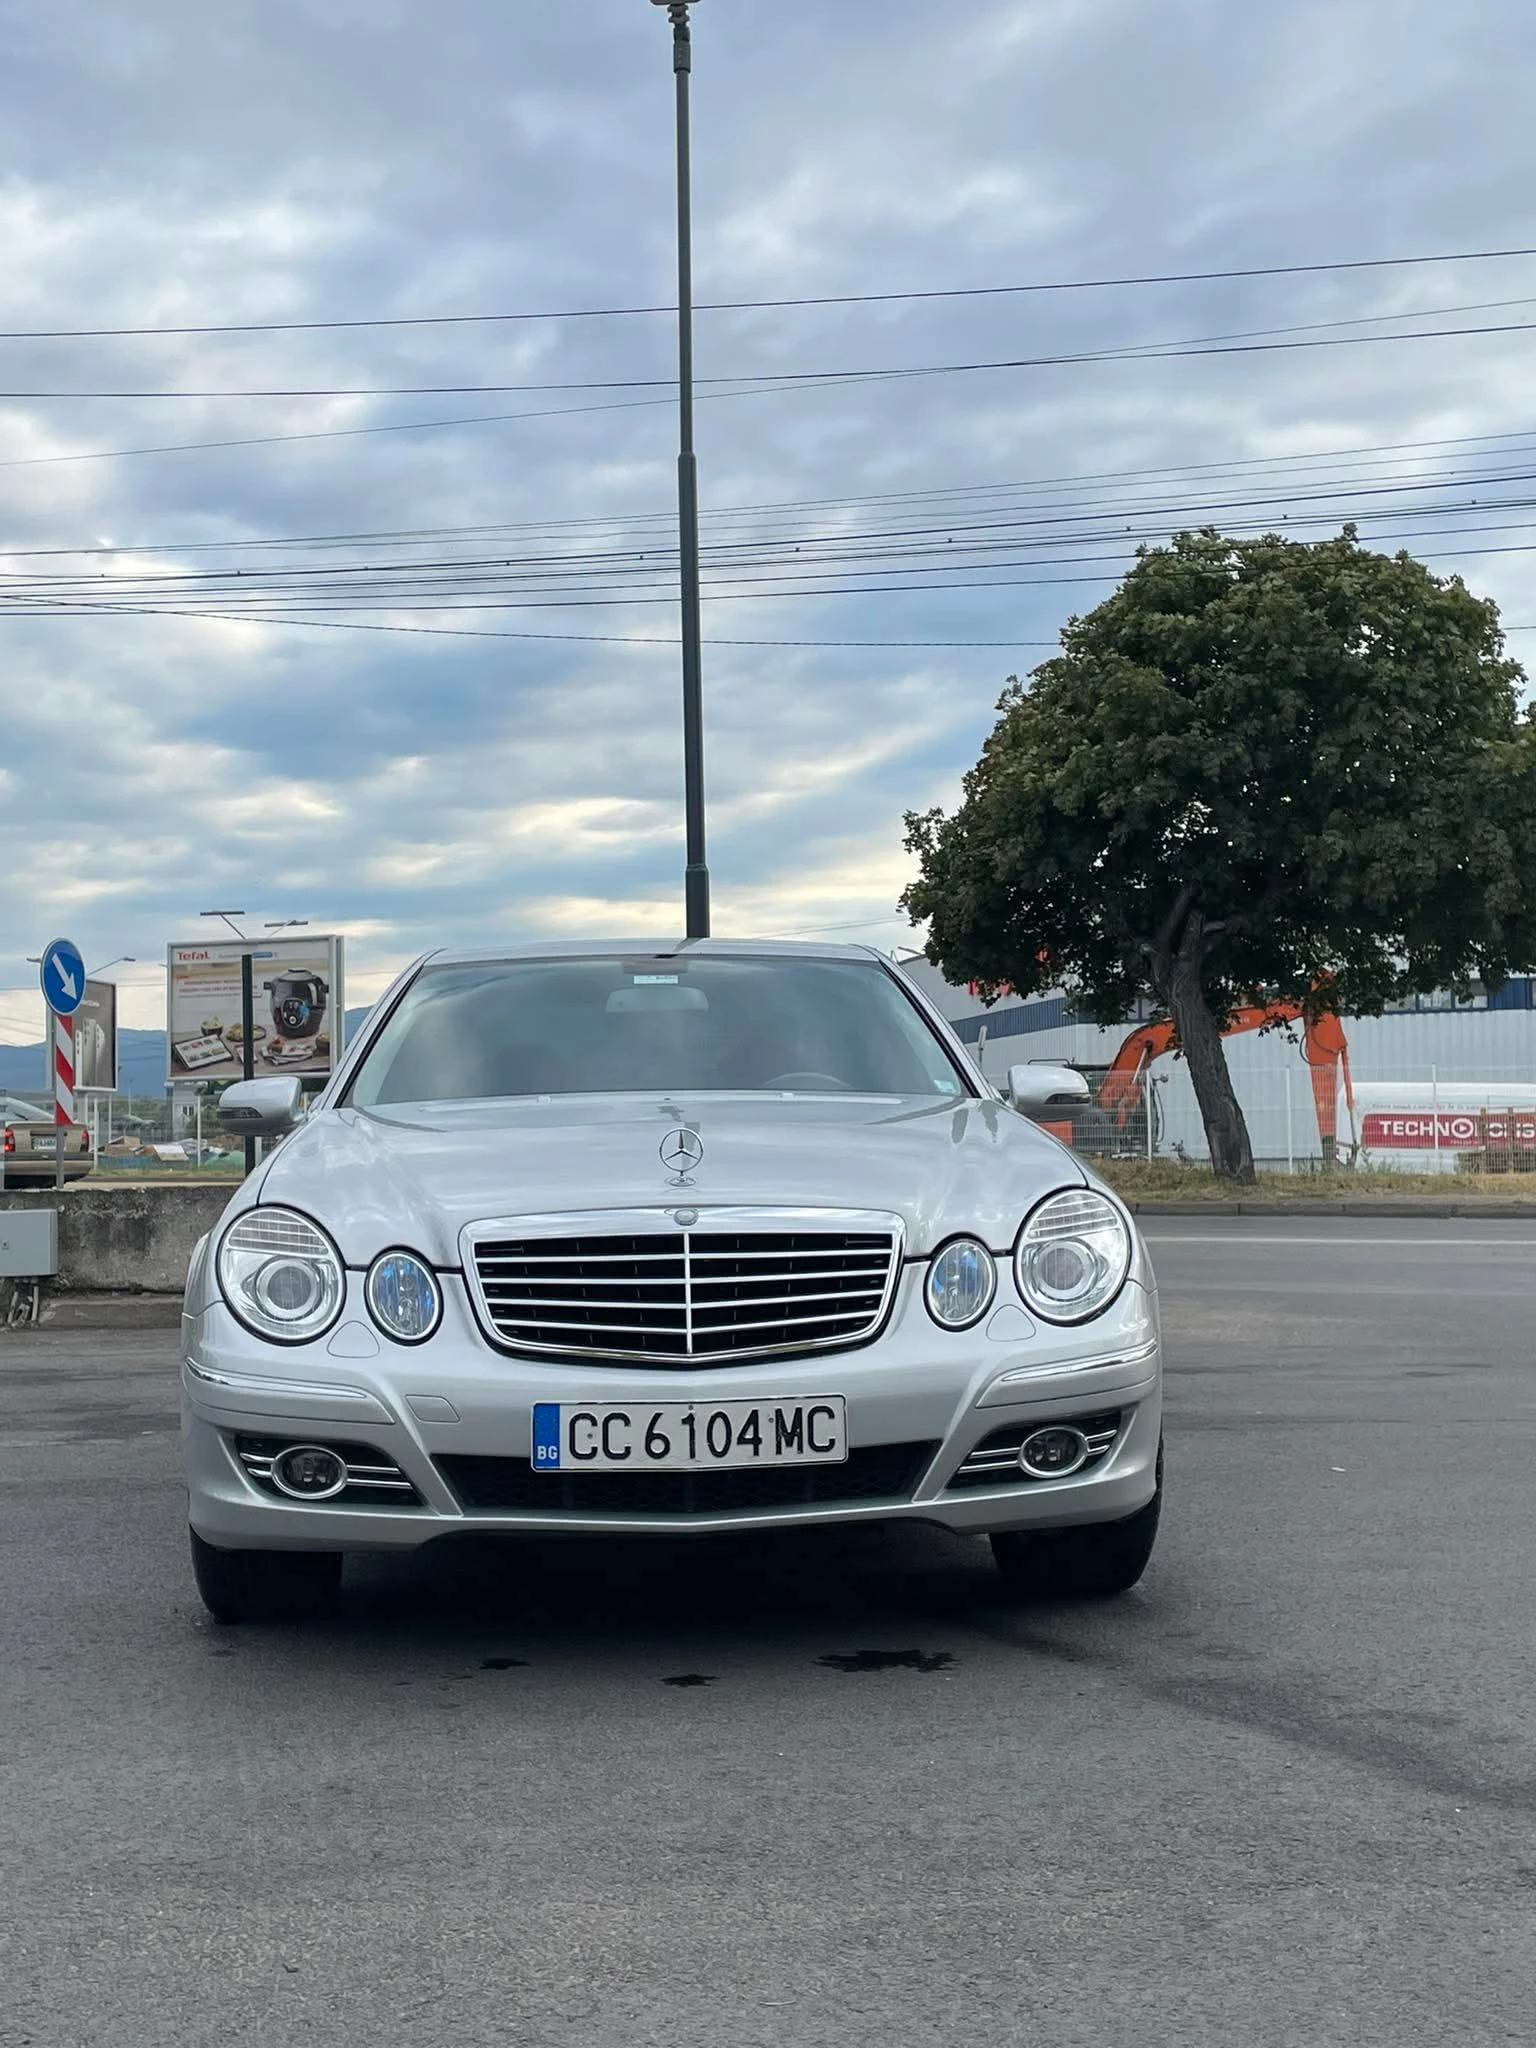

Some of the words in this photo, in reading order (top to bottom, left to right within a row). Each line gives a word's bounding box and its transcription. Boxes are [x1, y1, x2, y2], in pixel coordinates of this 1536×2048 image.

[177, 951, 210, 961] Tefal
[644, 1409, 762, 1460] 6104
[536, 1445, 558, 1460] BG
